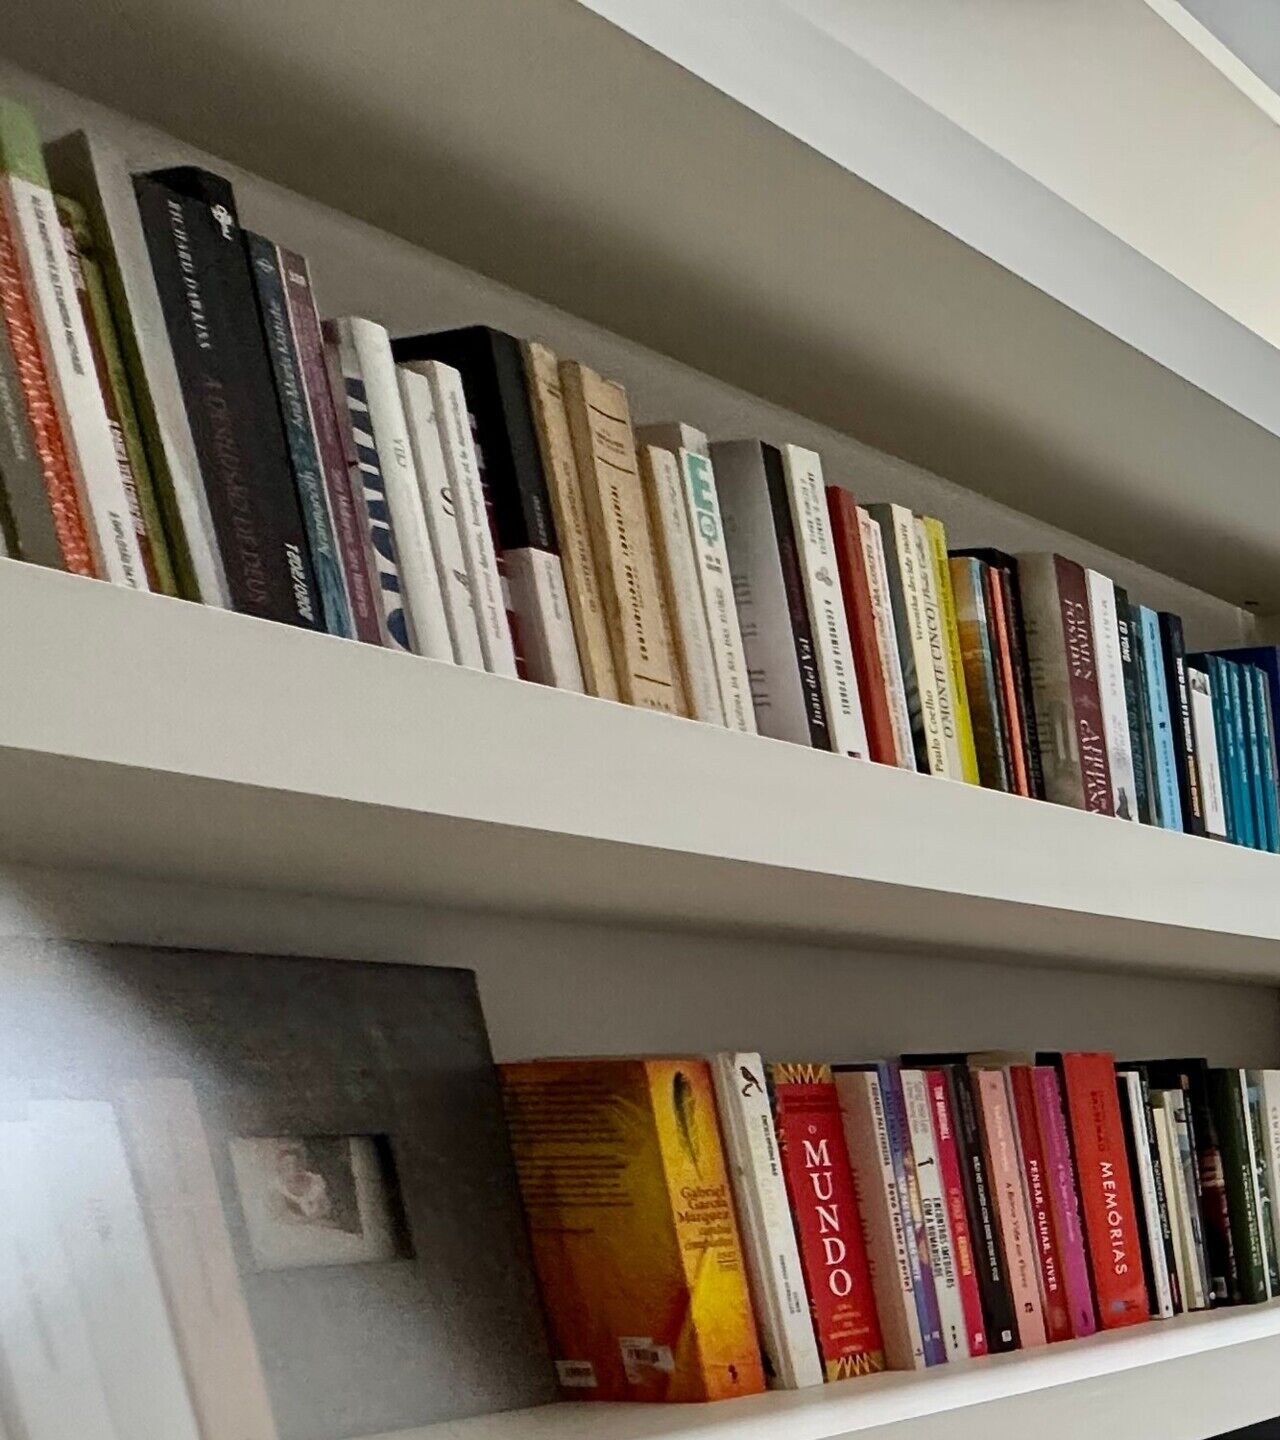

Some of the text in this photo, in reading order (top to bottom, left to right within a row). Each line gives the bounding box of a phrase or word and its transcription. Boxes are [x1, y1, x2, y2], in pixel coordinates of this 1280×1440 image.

[808, 1124, 818, 1135] O
[680, 1185, 725, 1200] Gabriel
[803, 1138, 852, 1298] MUNDO
[1099, 1161, 1129, 1275] MEMÓRIAS
